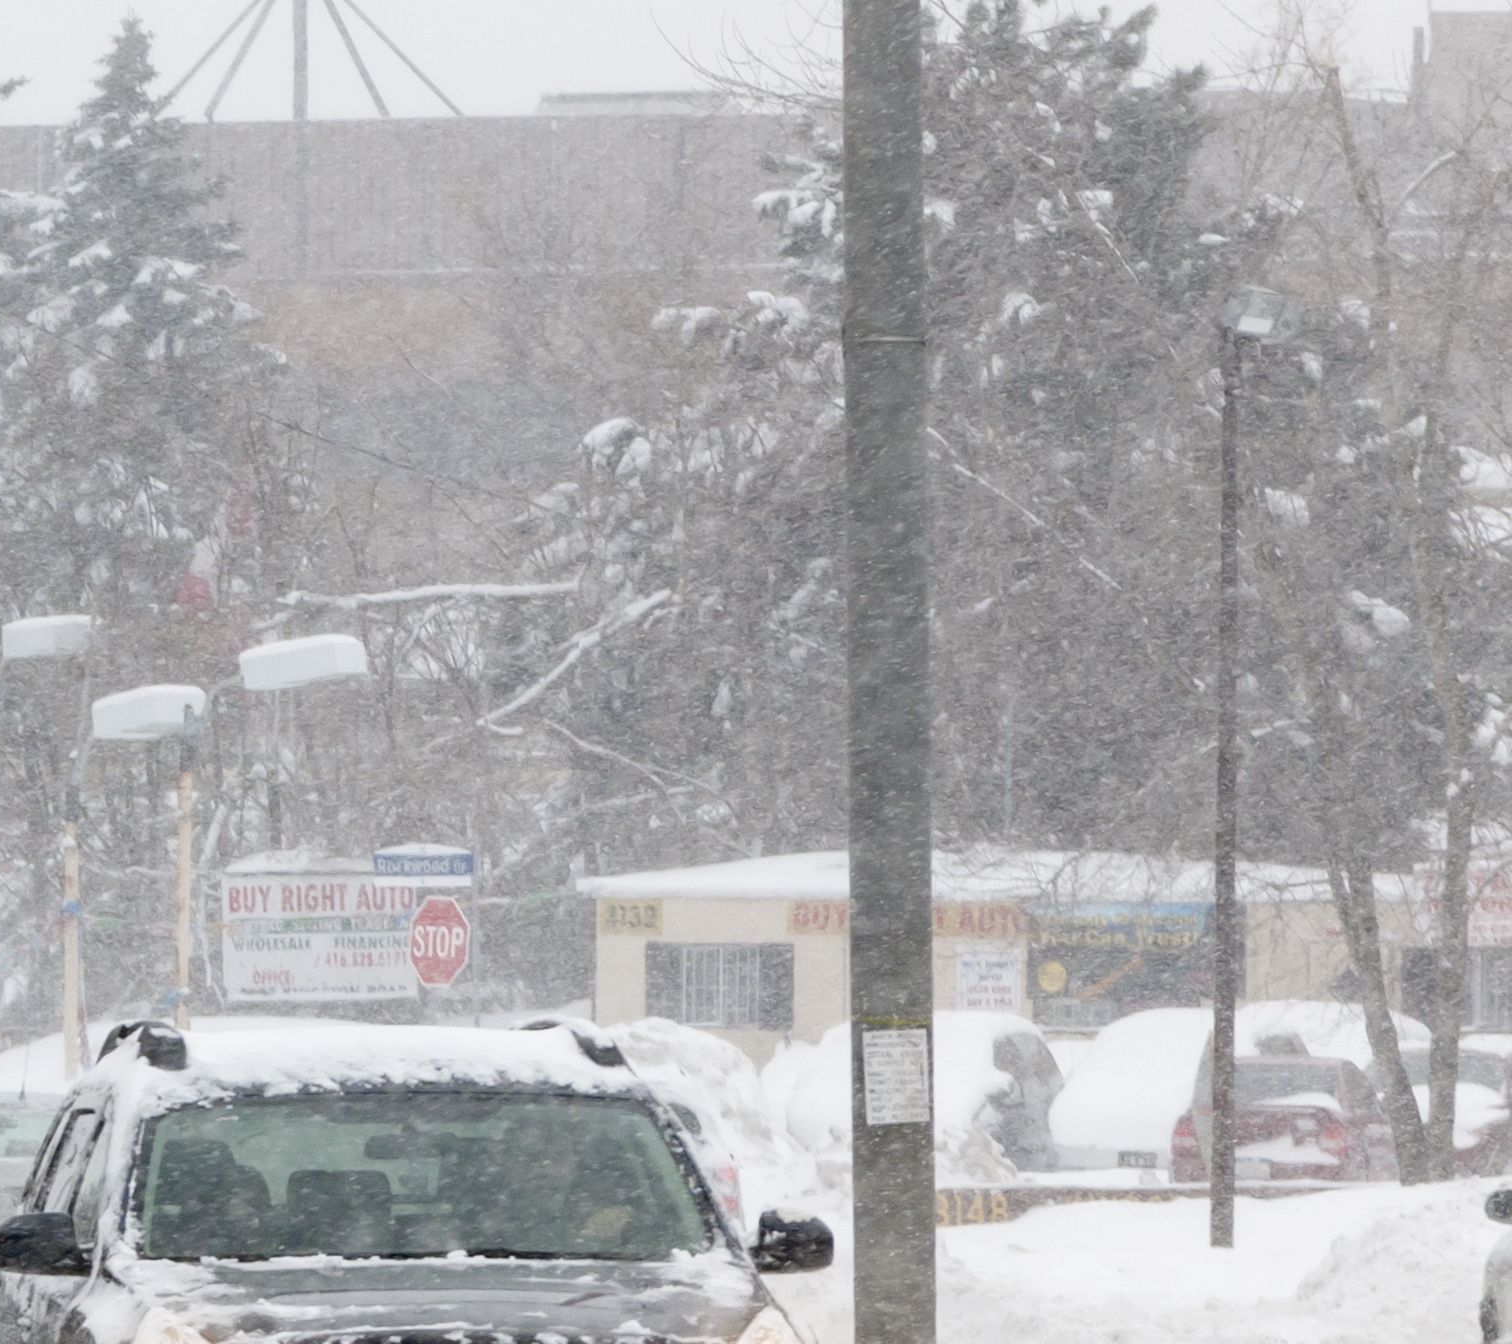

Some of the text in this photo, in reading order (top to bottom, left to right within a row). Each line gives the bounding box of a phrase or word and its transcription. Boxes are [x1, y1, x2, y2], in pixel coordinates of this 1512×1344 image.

[228, 883, 414, 913] BUY RIGHT AUTO
[231, 936, 312, 952] WHOLESALE
[413, 925, 464, 958] STOP
